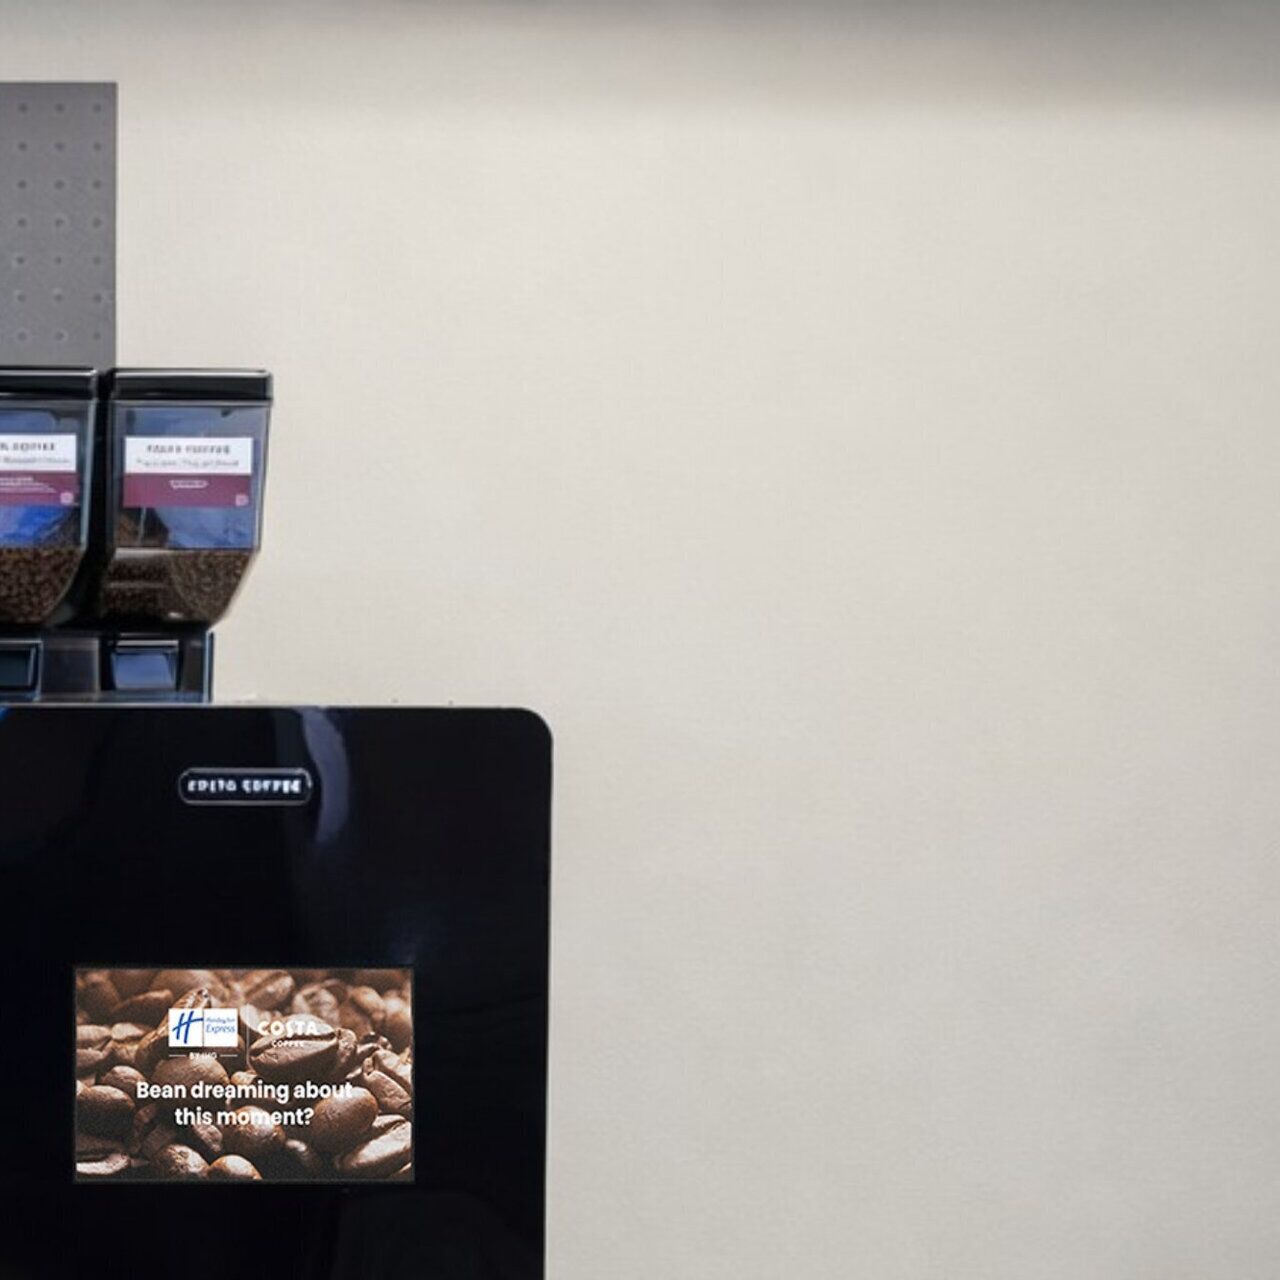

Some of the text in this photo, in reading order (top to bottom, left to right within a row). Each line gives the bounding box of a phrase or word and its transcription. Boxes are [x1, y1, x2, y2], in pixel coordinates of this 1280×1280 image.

[206, 1025, 235, 1034] Express
[258, 1021, 317, 1038] COSTA
[136, 1080, 353, 1104] Bean dreaming about
[175, 1107, 314, 1125] this moment?
